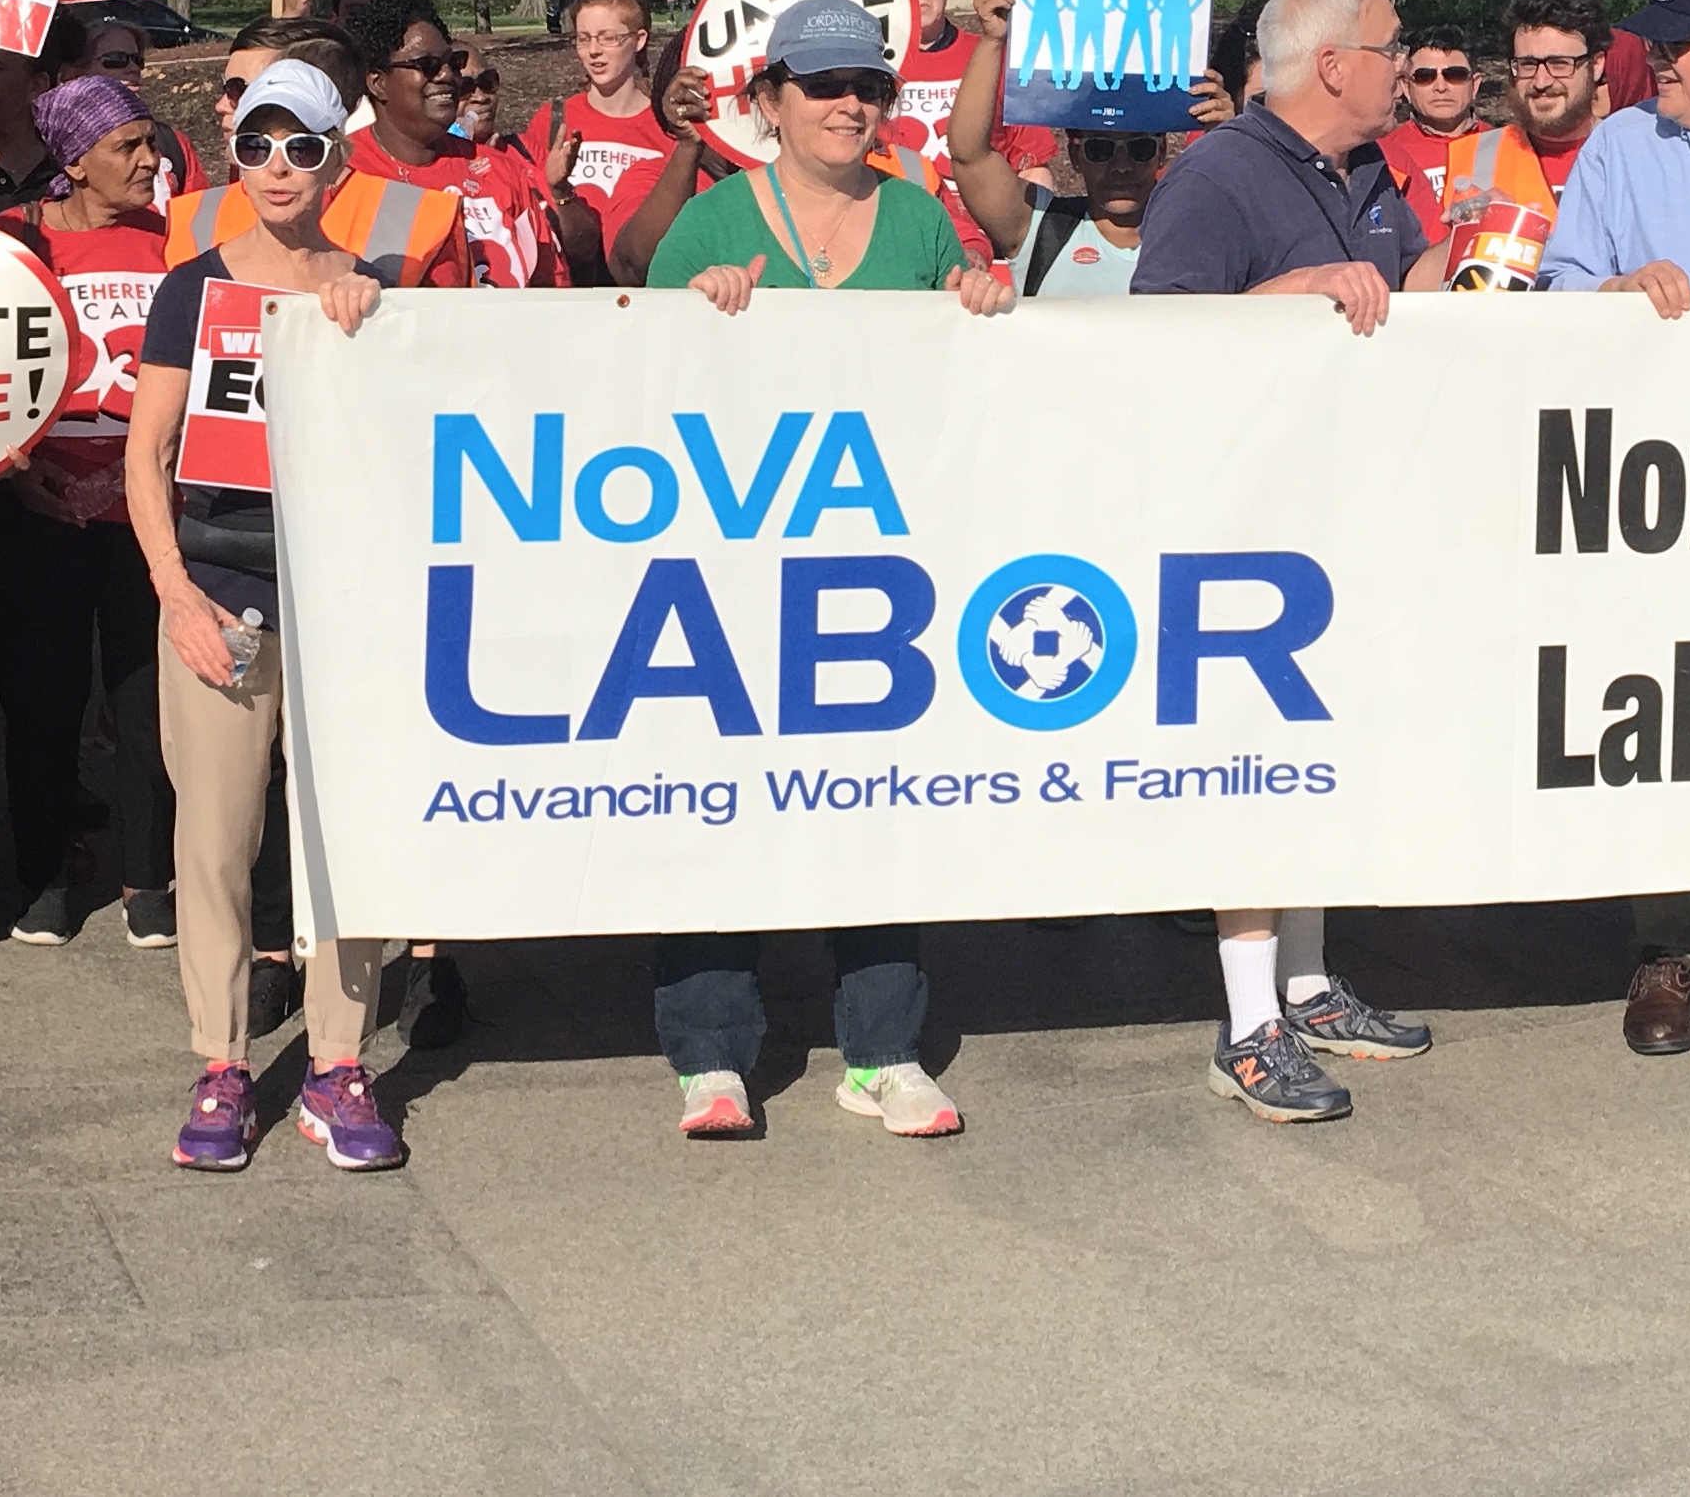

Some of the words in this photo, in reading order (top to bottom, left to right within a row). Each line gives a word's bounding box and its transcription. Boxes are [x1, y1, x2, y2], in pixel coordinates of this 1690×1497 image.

[803, 13, 850, 28] JORDAN
[1484, 237, 1538, 265] ARE
[430, 410, 912, 544] NoVA
[425, 550, 1336, 746] LABOR
[423, 774, 738, 826] Advancing
[766, 761, 1021, 815] Workers
[1039, 760, 1083, 802] &
[1105, 753, 1337, 800] Families
